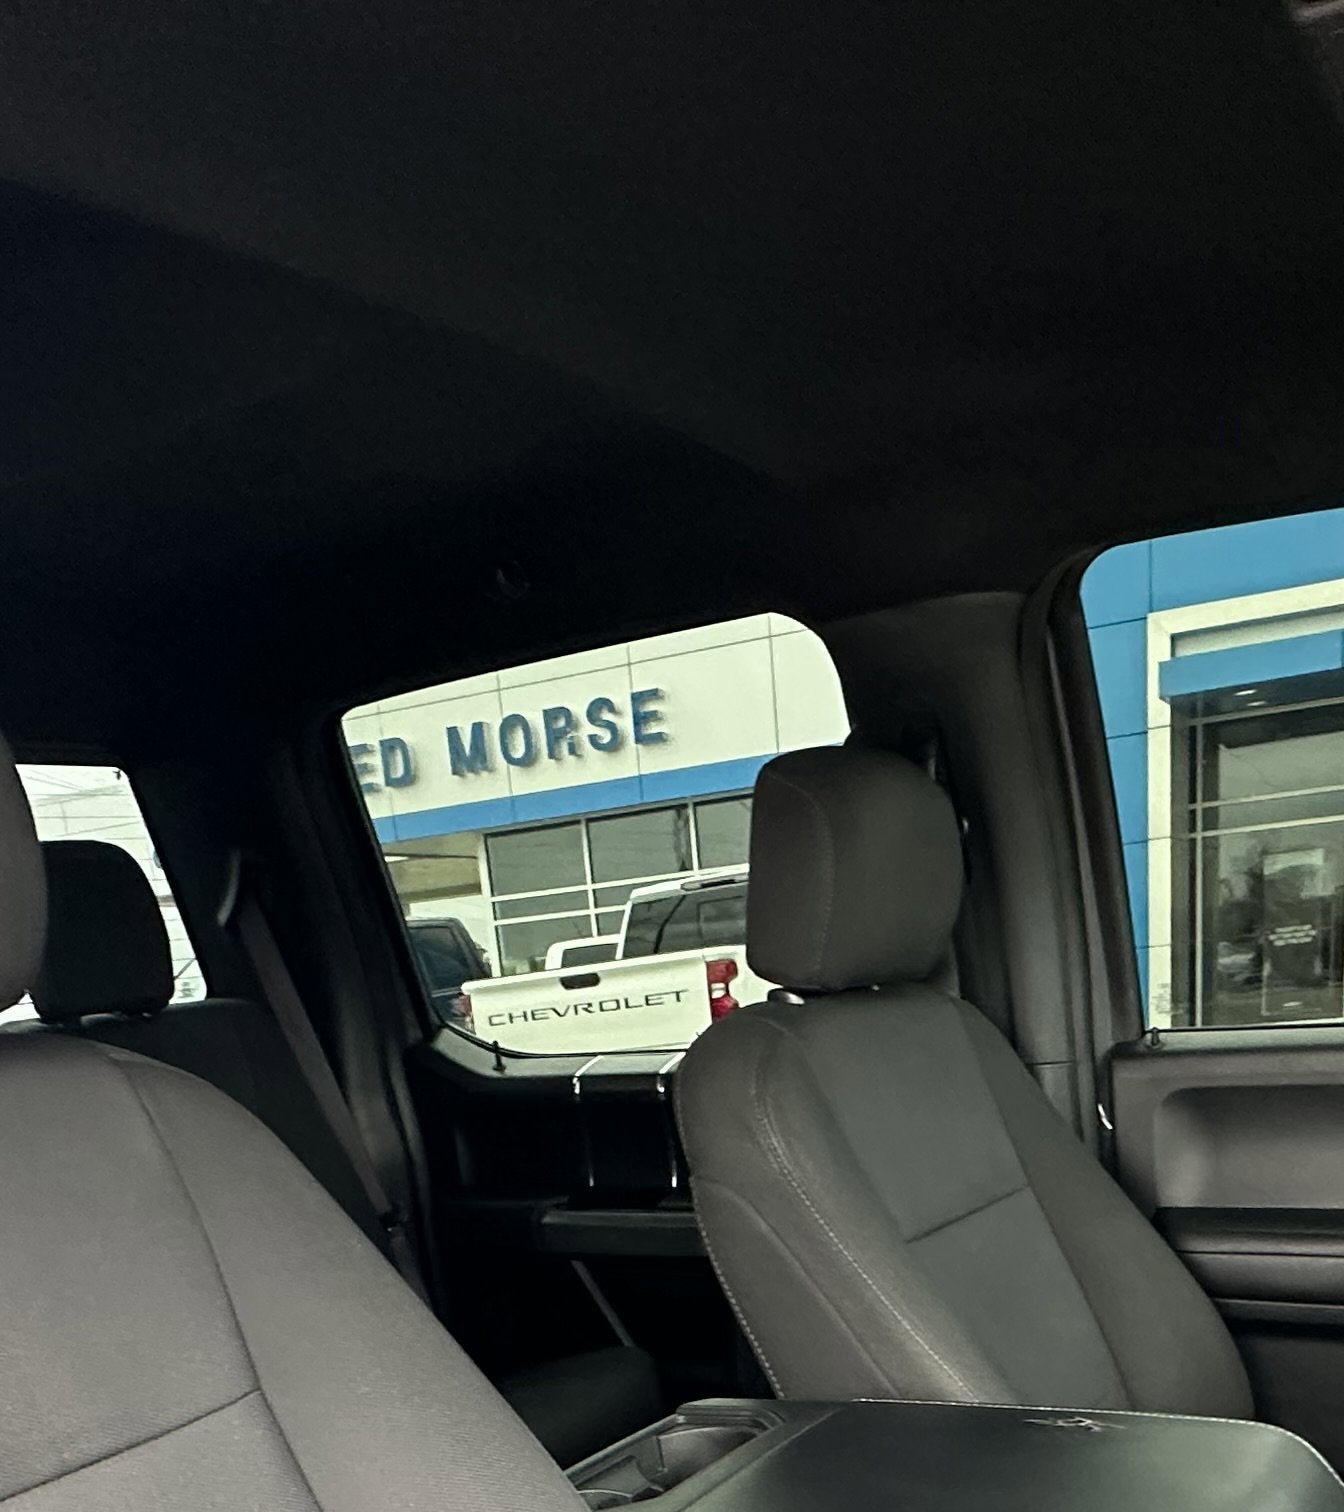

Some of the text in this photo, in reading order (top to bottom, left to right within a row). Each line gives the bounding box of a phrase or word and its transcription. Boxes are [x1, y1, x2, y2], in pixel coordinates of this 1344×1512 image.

[348, 688, 668, 794] ED MORSE
[488, 989, 689, 1027] CHEVROLET
